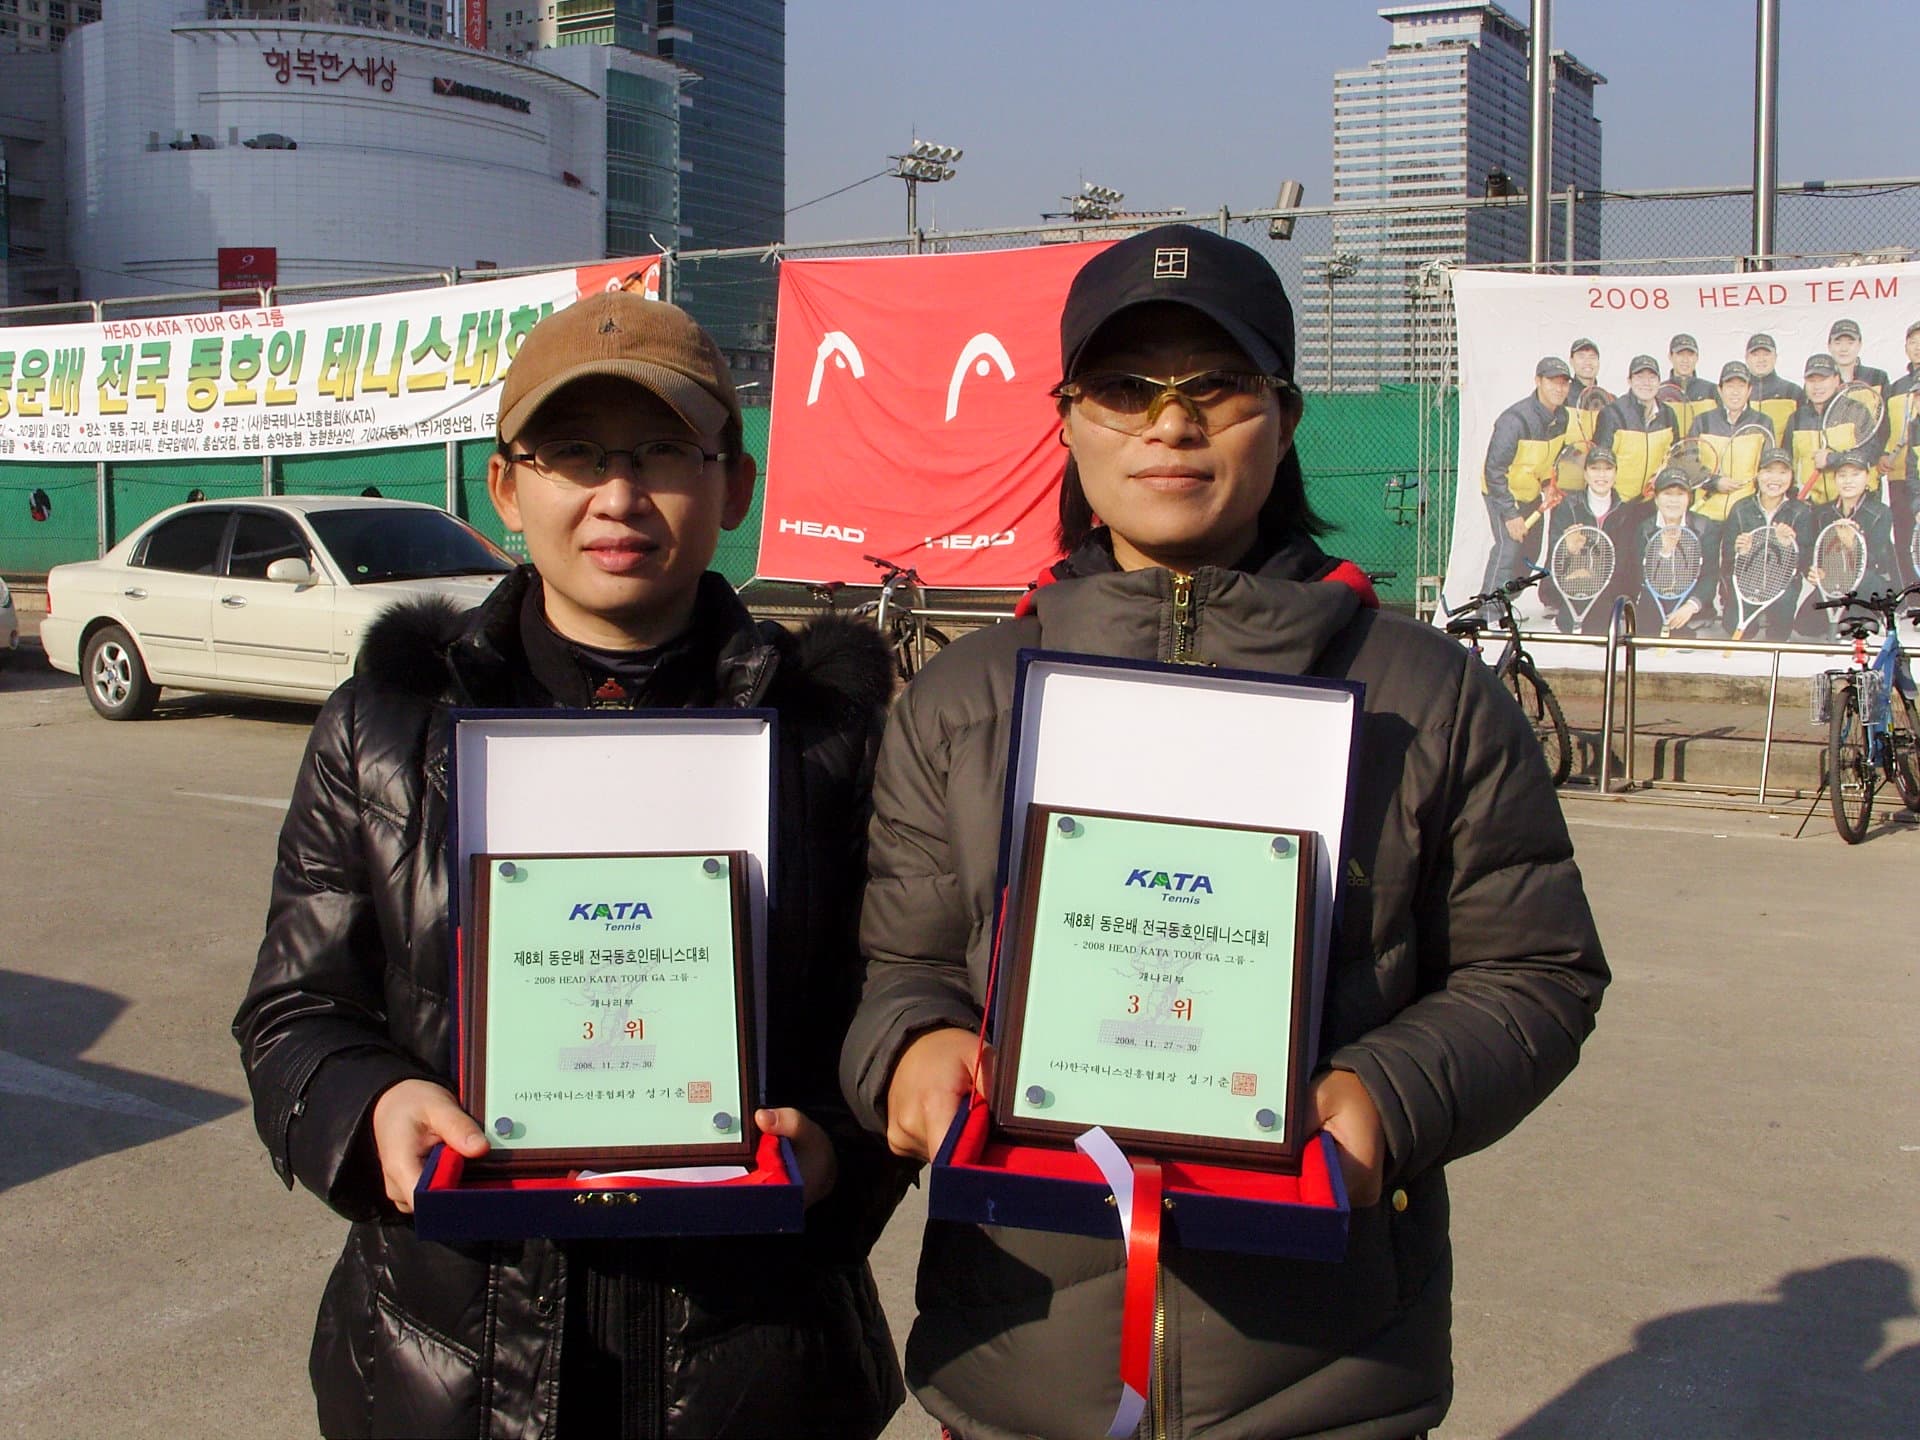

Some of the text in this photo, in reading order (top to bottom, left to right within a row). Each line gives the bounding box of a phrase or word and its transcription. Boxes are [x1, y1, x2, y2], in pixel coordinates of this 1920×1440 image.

[1588, 277, 1899, 310] 2008 HEAD TEAM
[103, 309, 285, 340] HEAD KATA TOUR GA 그룹
[97, 341, 172, 416] 전국
[187, 329, 306, 413] 동호인
[51, 423, 71, 438] 4일간
[131, 420, 149, 436] 구리,
[152, 419, 168, 435] 부천
[171, 418, 204, 435] 테니스장
[222, 416, 239, 432] 주관
[52, 441, 70, 454] FNC
[779, 518, 865, 543] HEAD
[925, 530, 1016, 549] HEAD
[1125, 869, 1214, 894] KATA
[1161, 893, 1201, 905] Tennis
[568, 902, 653, 920] KATA
[604, 922, 642, 931] Tennis
[1063, 911, 1269, 947] 제8회 동운배 전국동호인테니스대회
[513, 946, 709, 967] 제8회 동운배 전국동호인테니스대회
[1082, 941, 1105, 951] 2008
[1109, 943, 1137, 954] HEAD
[1140, 946, 1169, 957] KATA
[1174, 949, 1202, 960] TOUR
[1206, 953, 1220, 962] GA
[534, 976, 555, 985] 2008
[559, 975, 586, 984] HEAD
[590, 975, 617, 984] KATA
[621, 974, 648, 982] TOUR
[651, 973, 666, 982] GA
[1127, 994, 1193, 1021] 3 위
[582, 1018, 645, 1040] 3 위
